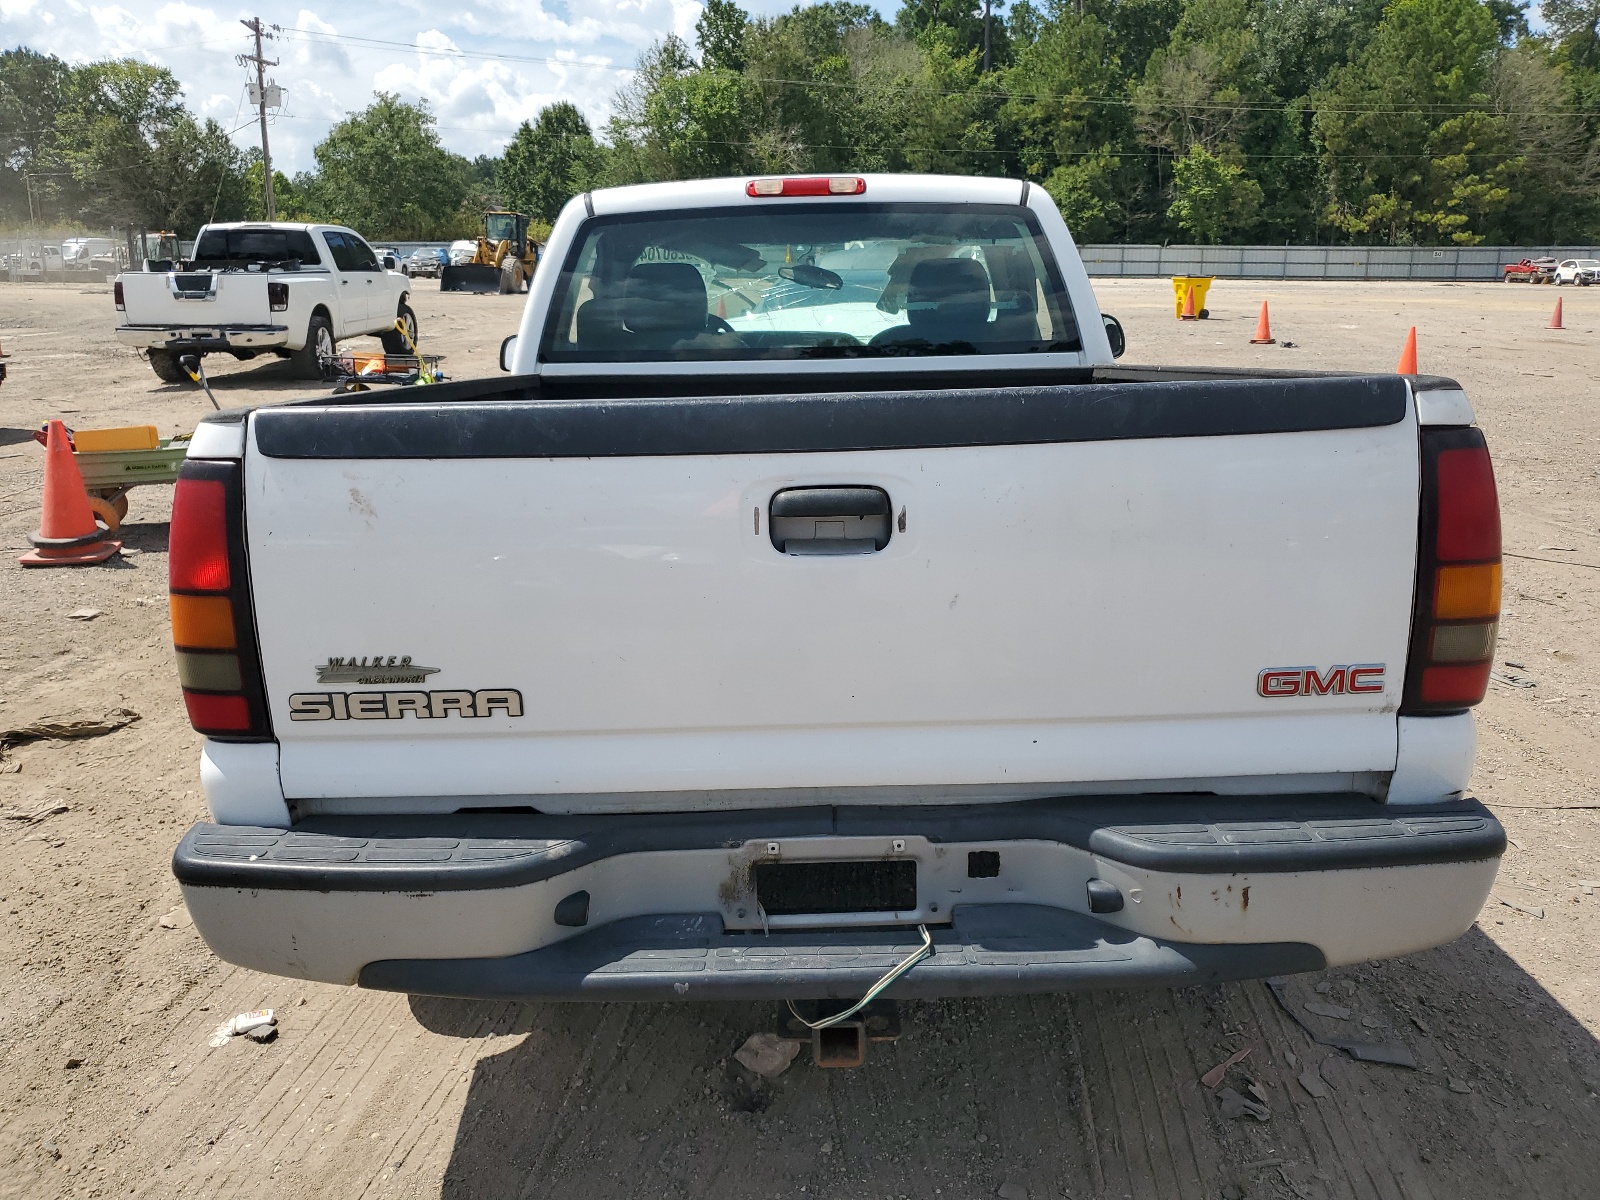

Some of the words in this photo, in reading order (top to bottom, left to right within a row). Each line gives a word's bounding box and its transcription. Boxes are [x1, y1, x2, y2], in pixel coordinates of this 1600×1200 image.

[328, 655, 412, 672] WALKER
[1257, 663, 1386, 697] GMC
[289, 688, 524, 721] SIERRA
